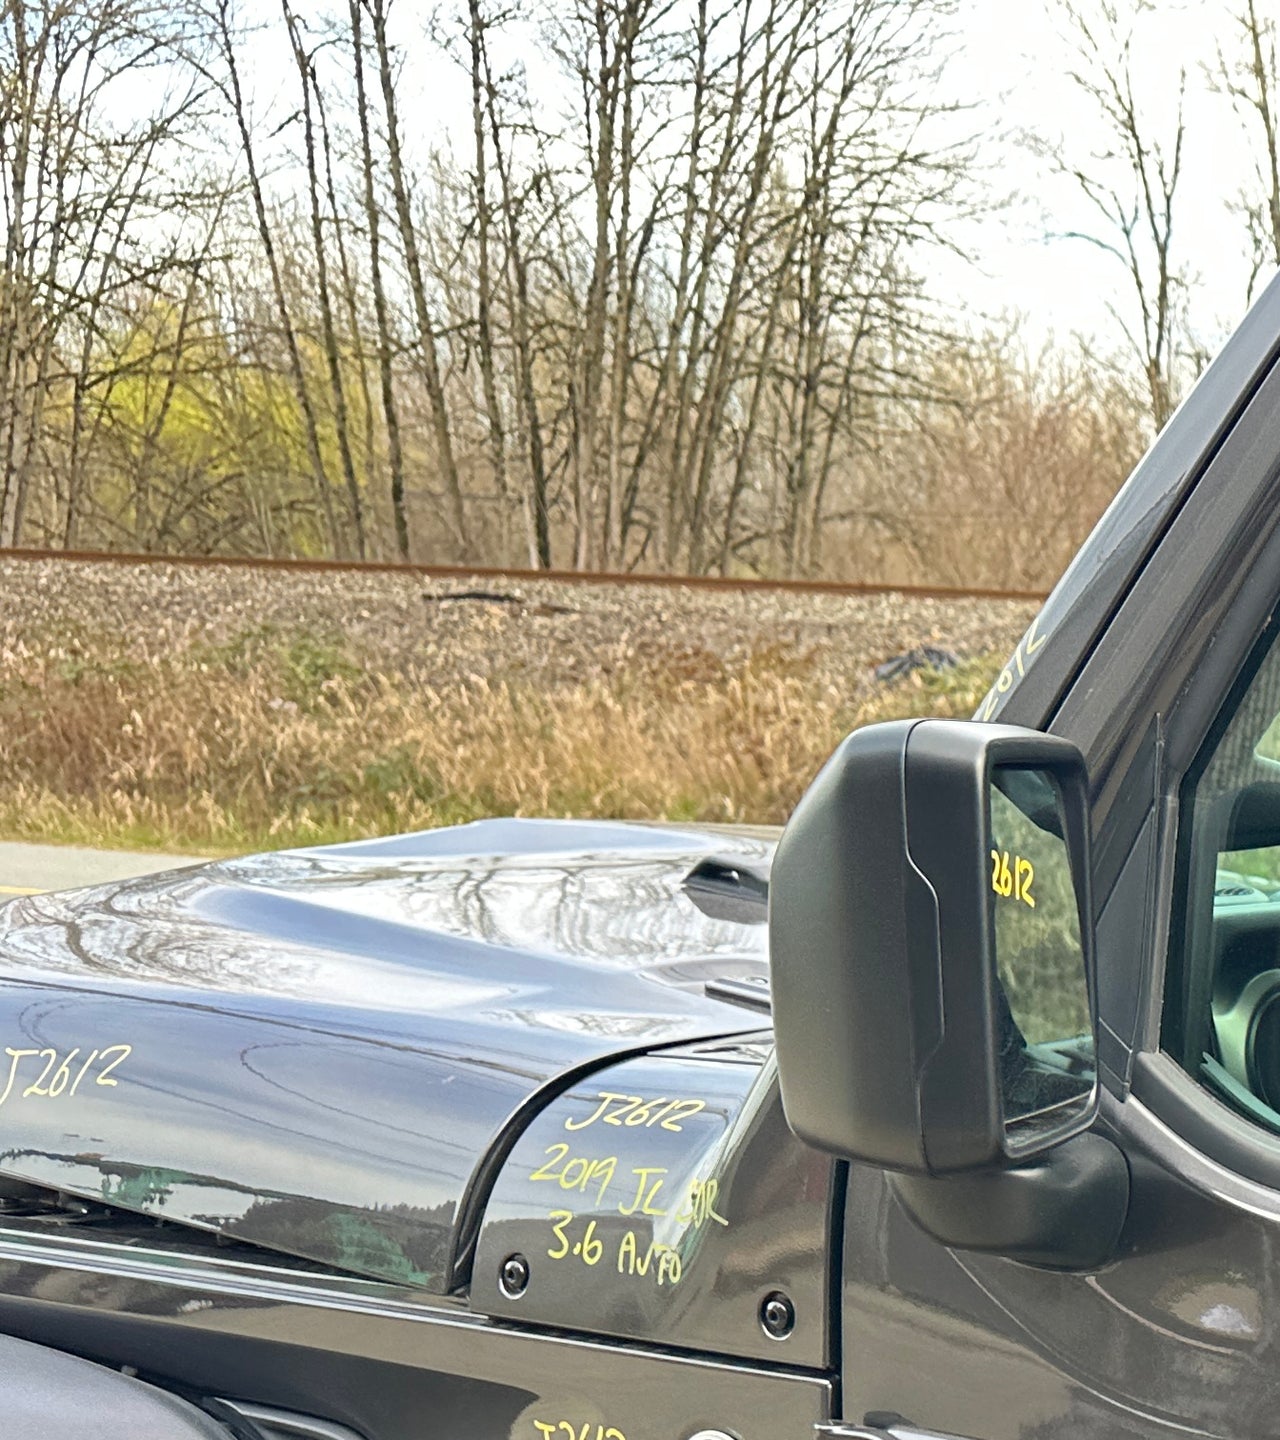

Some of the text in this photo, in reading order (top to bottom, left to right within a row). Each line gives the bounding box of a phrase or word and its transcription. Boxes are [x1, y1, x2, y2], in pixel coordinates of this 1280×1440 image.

[0, 1044, 132, 1104] J2612
[565, 1091, 706, 1132] J2612
[529, 1143, 618, 1207] 2019
[618, 1168, 668, 1216] JL
[548, 1210, 682, 1286] 3.6 AUTO
